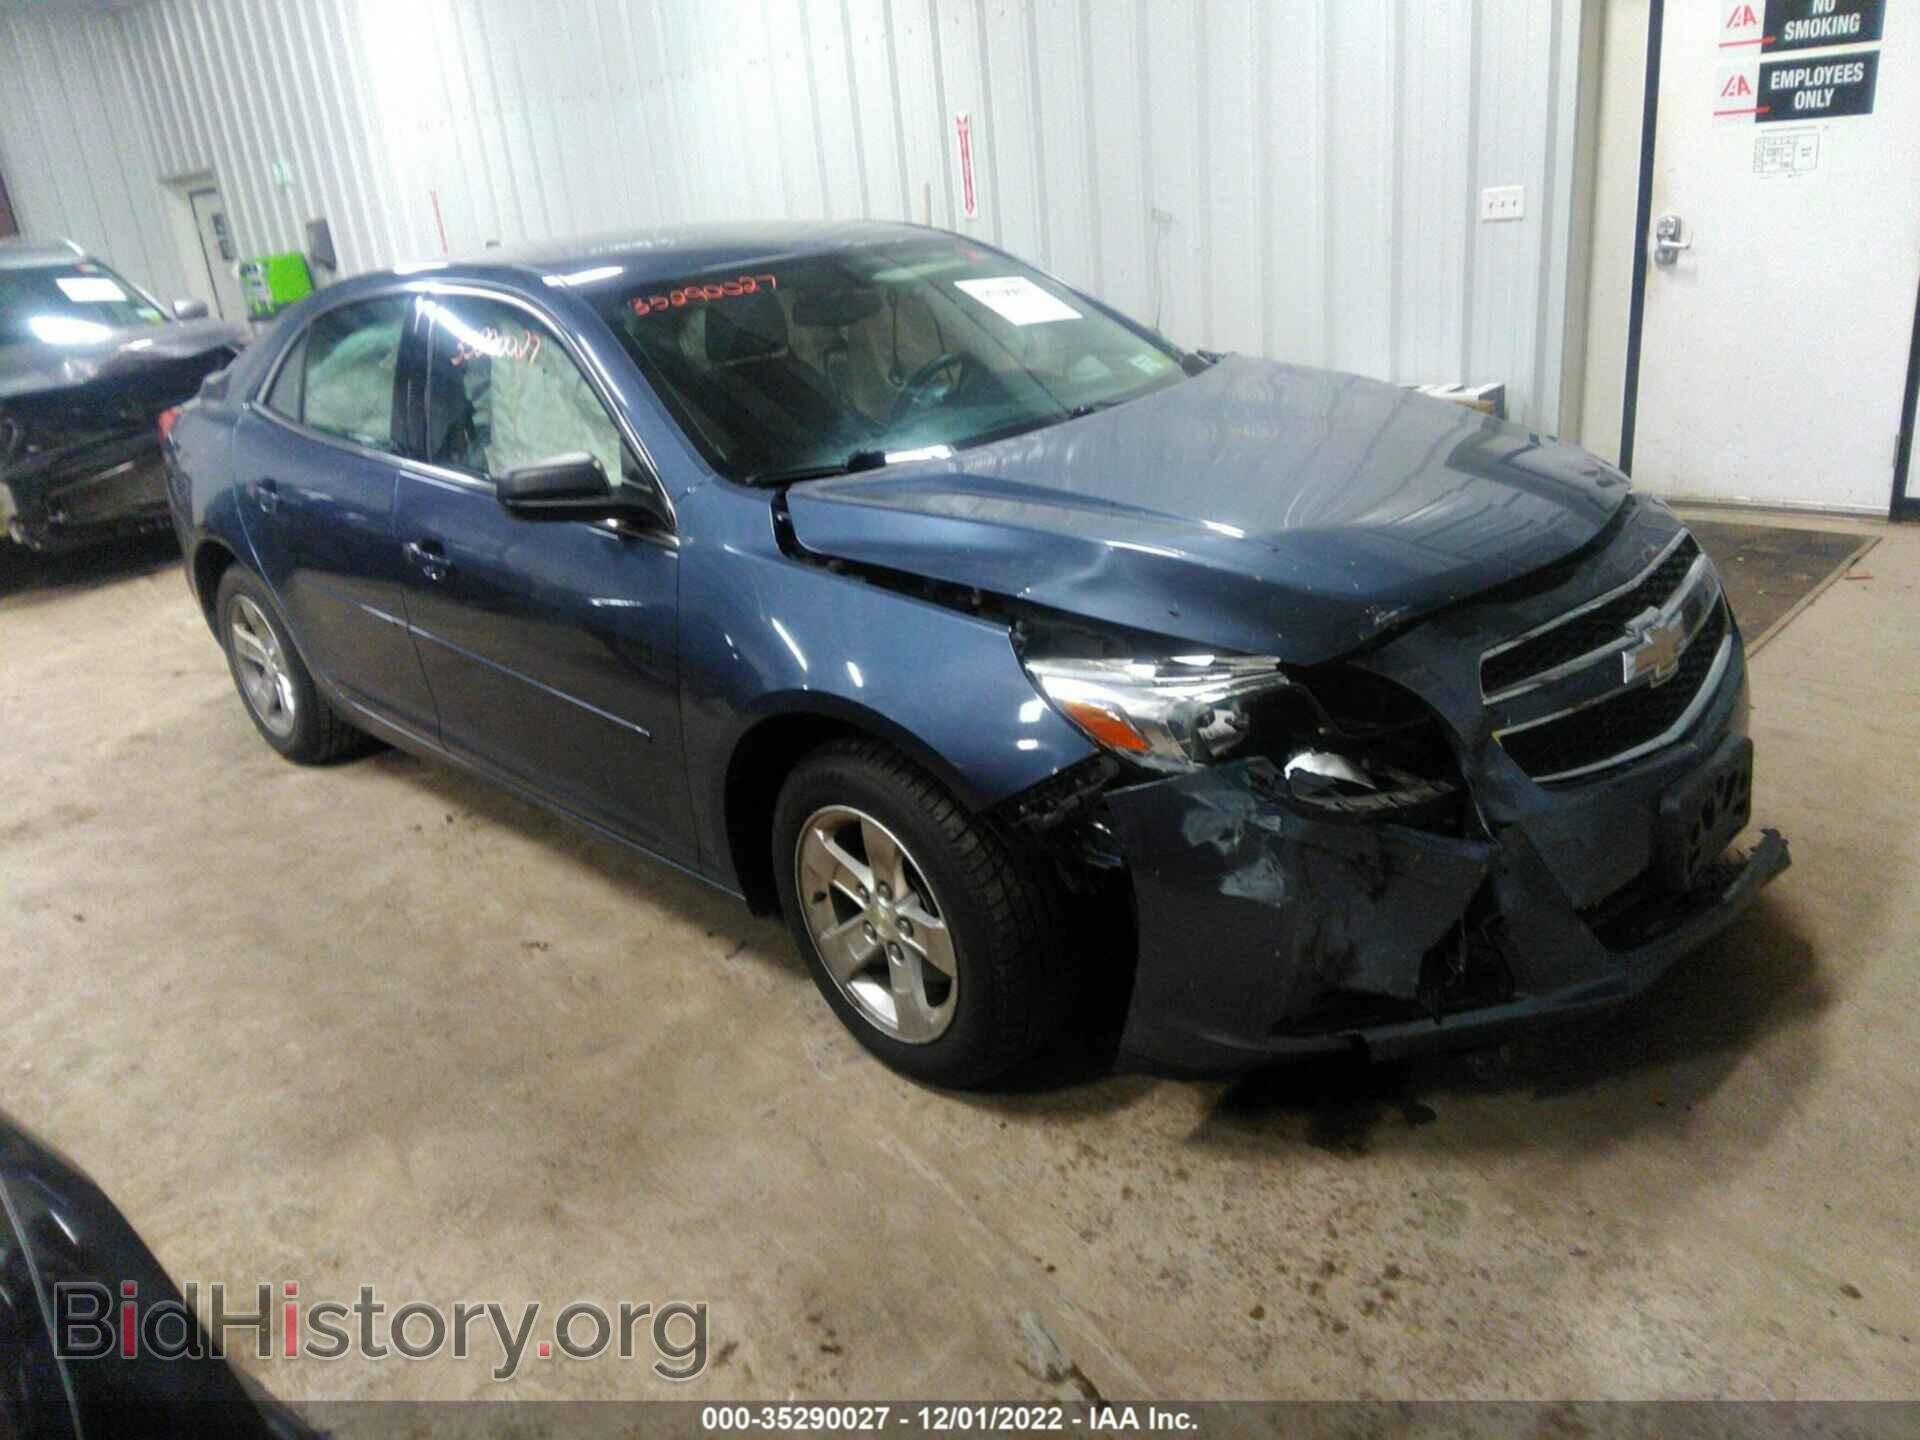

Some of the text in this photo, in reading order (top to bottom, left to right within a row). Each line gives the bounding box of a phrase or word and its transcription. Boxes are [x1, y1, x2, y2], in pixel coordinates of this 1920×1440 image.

[1812, 0, 1835, 13] NO
[1784, 13, 1861, 41] SMOKING
[1770, 62, 1864, 90] EMPLOYEES
[1794, 88, 1835, 110] ONLY
